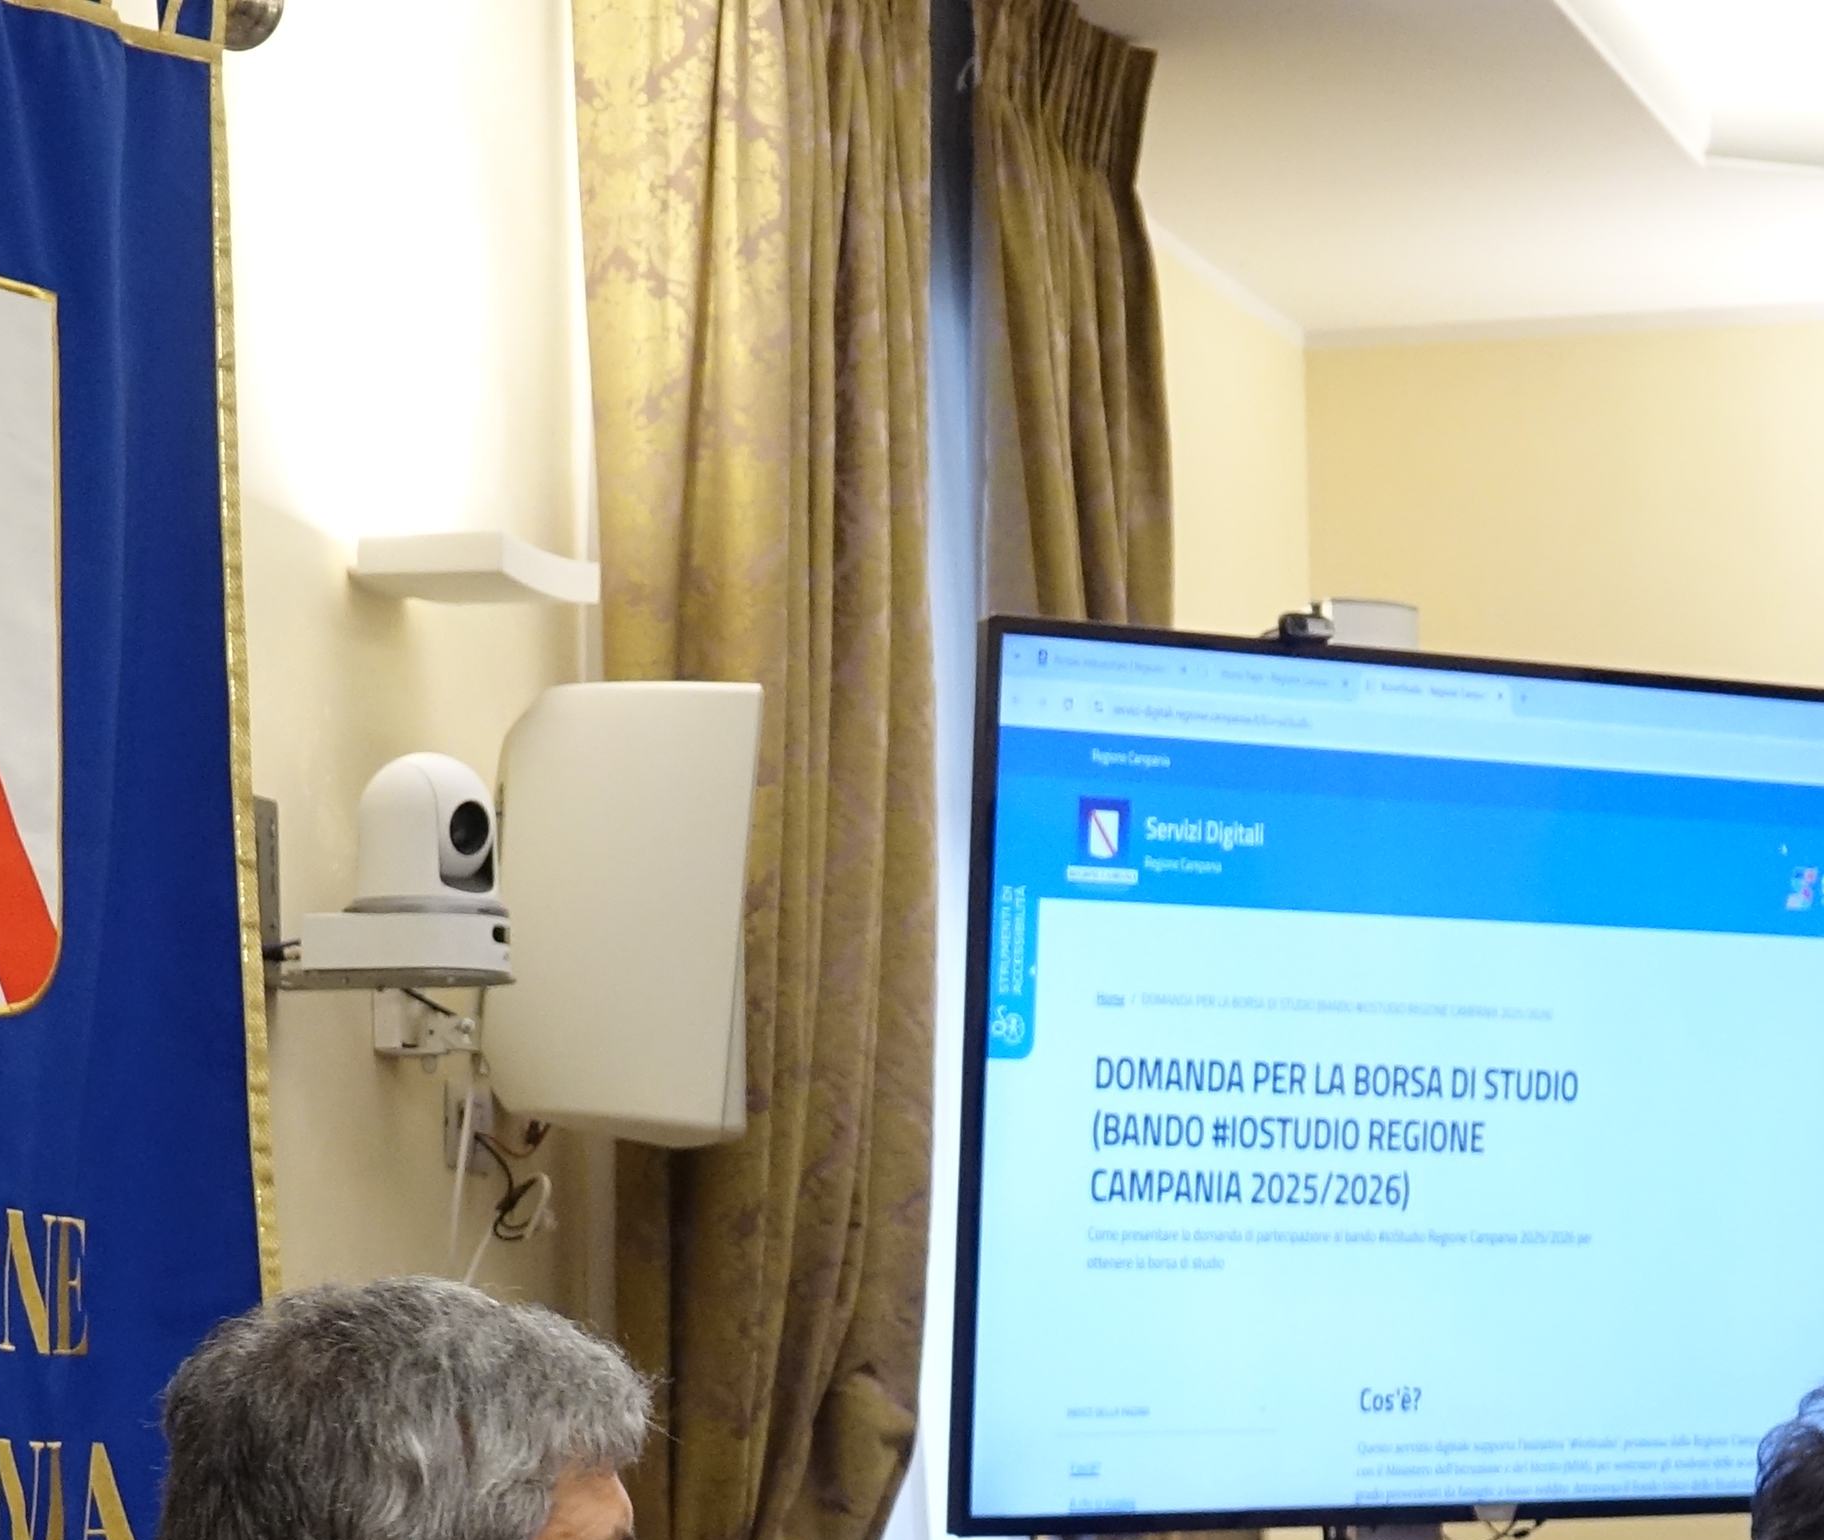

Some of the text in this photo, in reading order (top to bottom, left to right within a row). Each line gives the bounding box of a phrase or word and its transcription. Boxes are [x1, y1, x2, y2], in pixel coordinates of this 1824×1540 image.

[1145, 816, 1265, 851] Servizi Digitali
[1095, 1056, 1578, 1102] DOMANDA PER LA BORSA DI STUDIO
[1093, 1110, 1485, 1153] (BANDO #IOSTUDIO REGIONE
[1090, 1168, 1411, 1211] CAMPANIA 2025/2026)
[1360, 1385, 1422, 1413] Cos'è?
